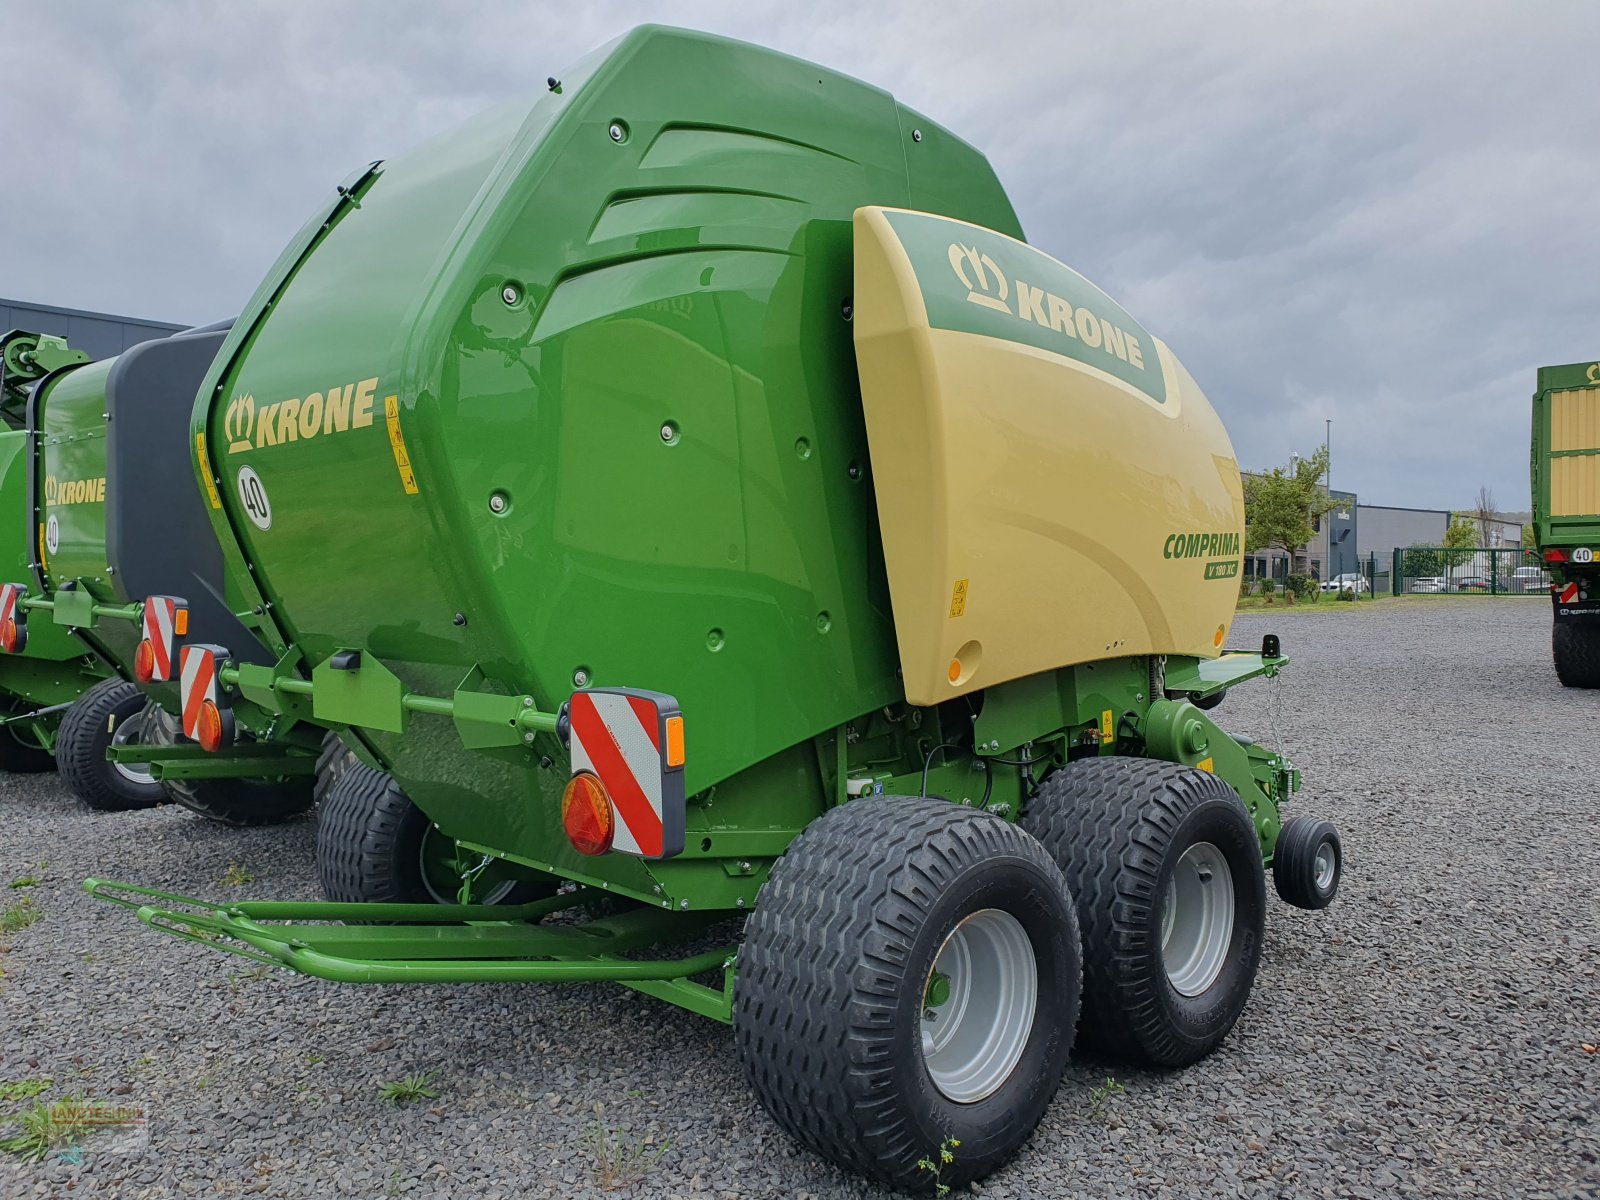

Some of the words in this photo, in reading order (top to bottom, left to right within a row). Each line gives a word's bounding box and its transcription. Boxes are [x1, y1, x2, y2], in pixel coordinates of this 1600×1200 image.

[1015, 279, 1145, 371] KRONE
[256, 377, 379, 449] KRONE
[57, 477, 106, 505] KRONE
[241, 476, 268, 518] 40
[1163, 532, 1240, 559] COMPRIMA
[1575, 549, 1590, 562] 40
[1208, 566, 1215, 577] V
[1226, 563, 1236, 575] XC
